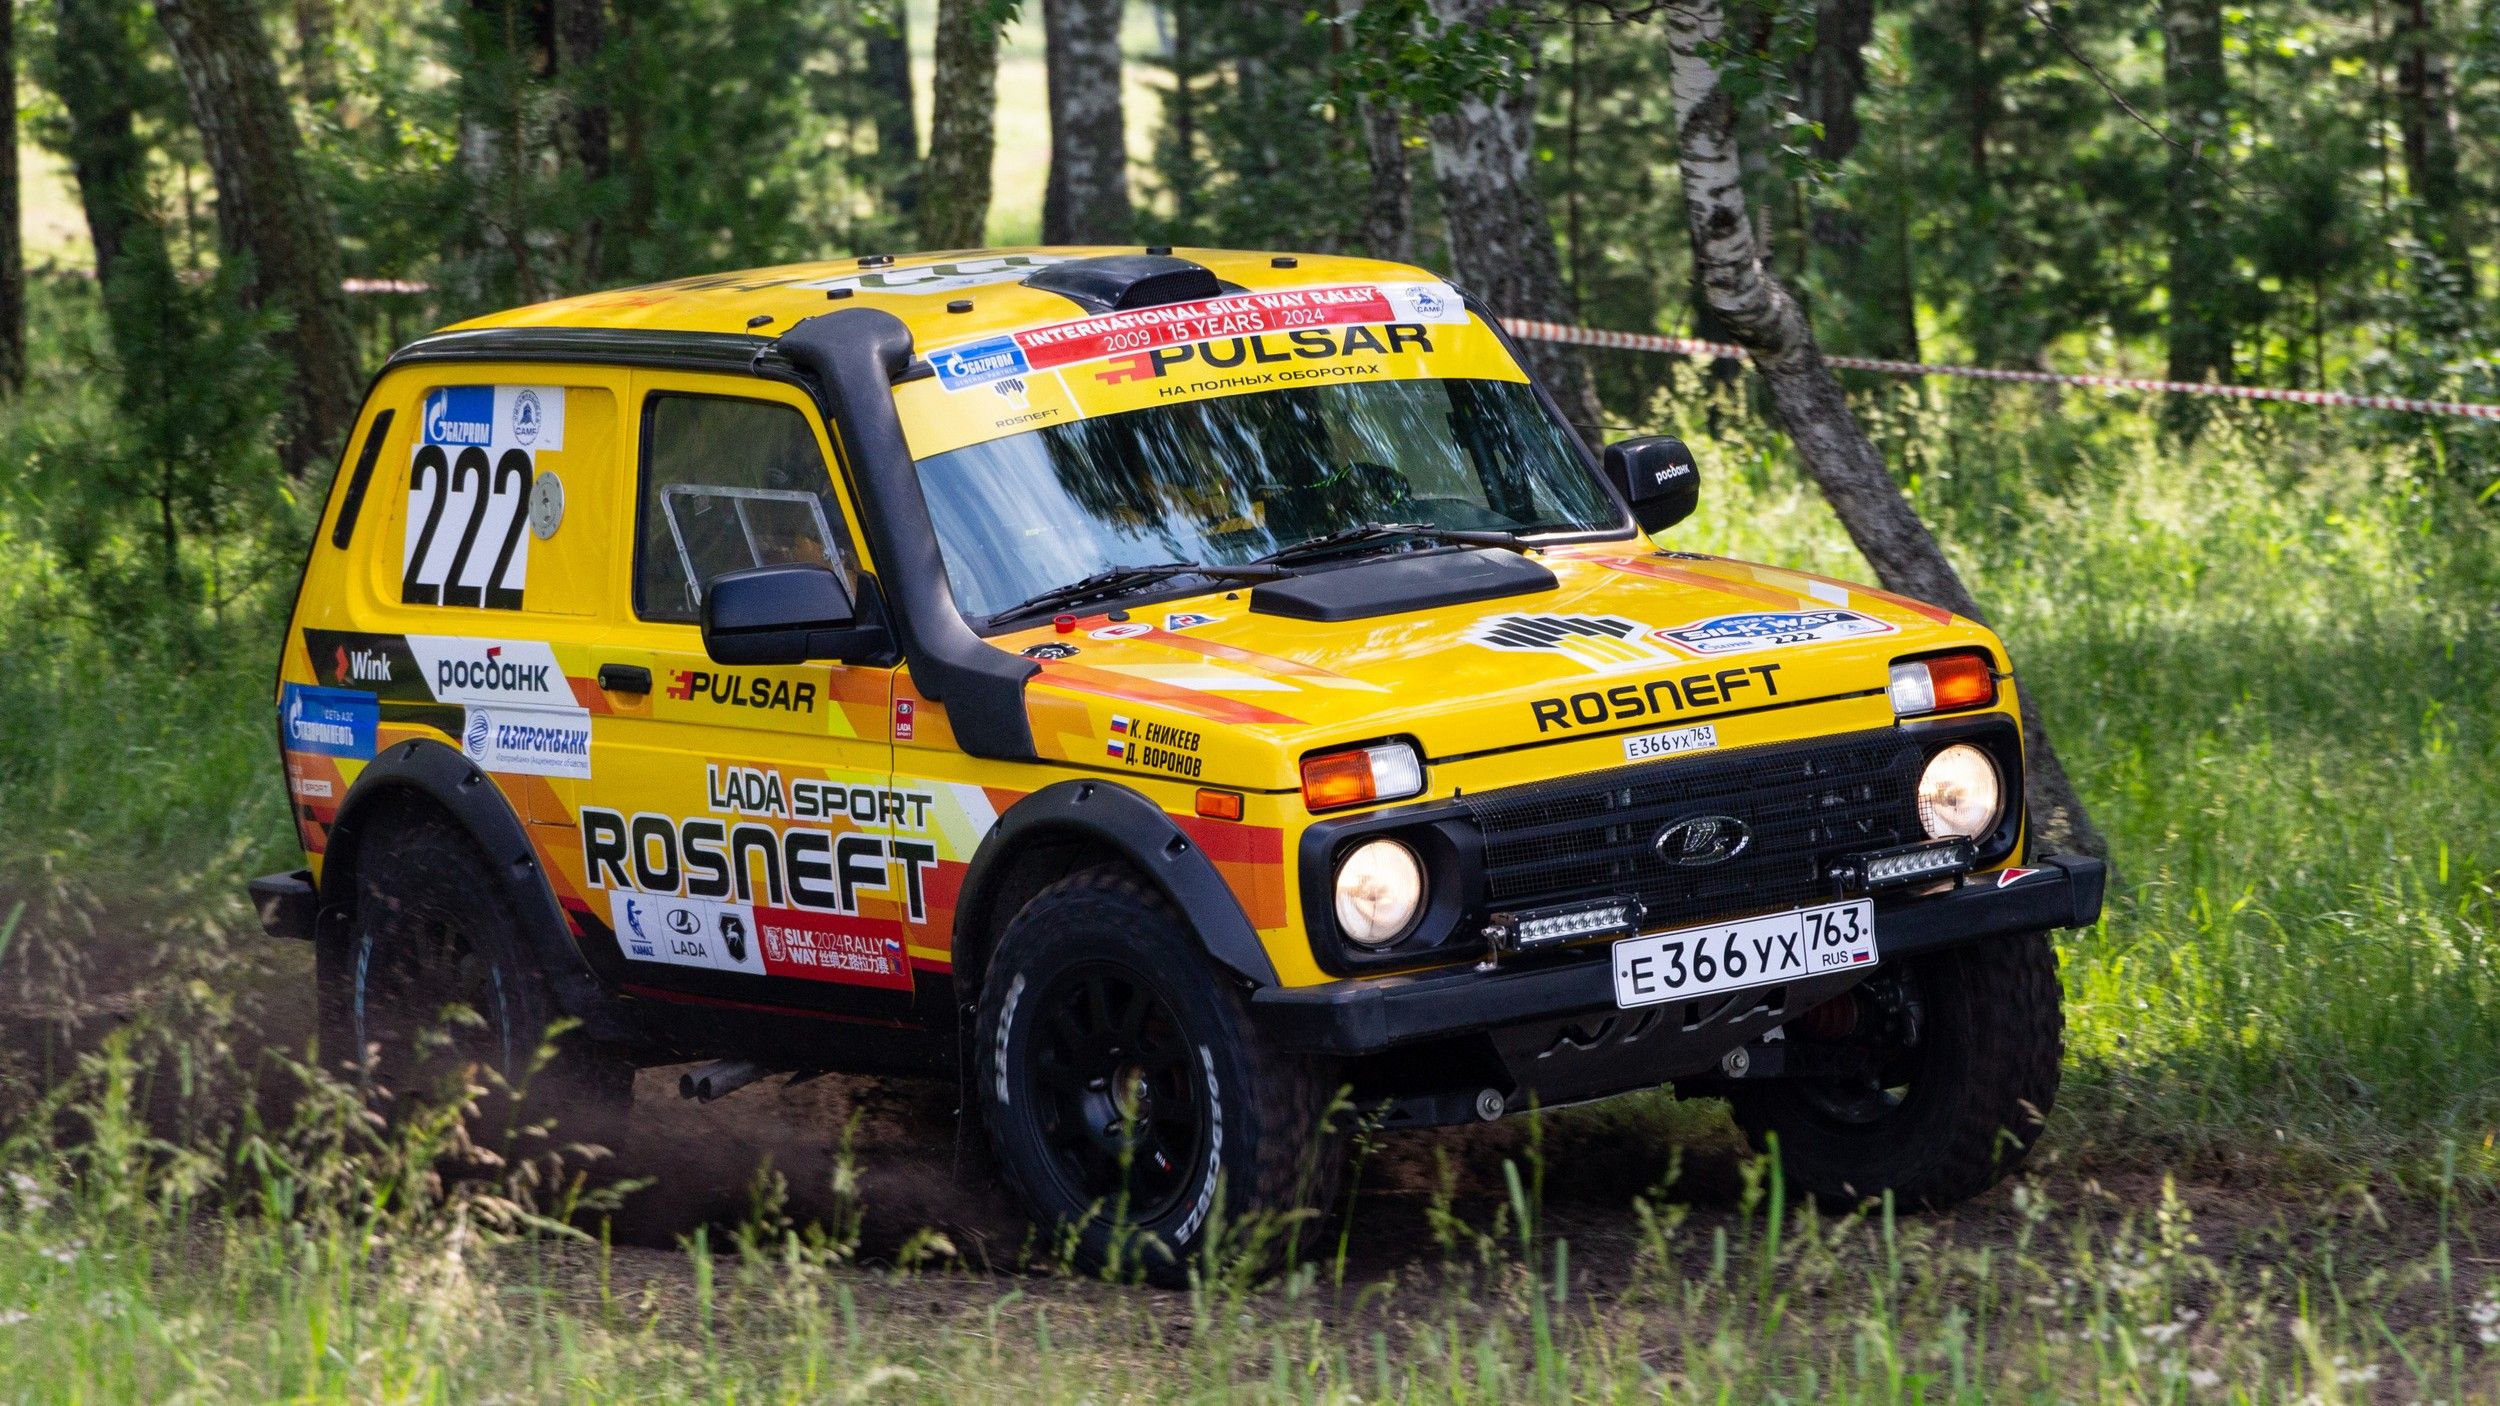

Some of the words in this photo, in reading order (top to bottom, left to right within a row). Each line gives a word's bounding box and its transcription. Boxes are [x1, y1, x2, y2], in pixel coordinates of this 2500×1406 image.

[1025, 304, 1207, 347] INTERNATIONAL
[1207, 297, 1256, 317] SILK
[1256, 290, 1308, 309] WAY
[1309, 287, 1376, 305] RALLY
[1104, 331, 1151, 352] 2009
[1167, 320, 1190, 342] 15
[1193, 313, 1265, 338] YEARS
[1283, 308, 1326, 326] 2024
[967, 352, 1015, 375] GAZPROM
[1150, 323, 1434, 377] PULSAR
[1159, 386, 1186, 397] НА
[1191, 374, 1274, 393] ПОЛНЫХ
[1278, 364, 1380, 381] ОБОРОТАХ
[448, 421, 490, 444] GAZPROM
[995, 408, 1059, 428] ROSNEFT
[402, 444, 534, 611] 222
[1682, 622, 1768, 641] SILK
[1765, 613, 1838, 629] WAY
[1766, 632, 1821, 644] 222
[351, 649, 392, 681] Wink
[438, 646, 549, 695] росбанк
[688, 671, 816, 714] PULSAR
[1531, 663, 1781, 732] ROSNEFT
[496, 725, 588, 755] ГАЗПРОМБАНК
[897, 723, 911, 731] LADA
[1130, 719, 1141, 739] К.
[1145, 722, 1200, 751] ЕНИКЕЕВ
[1690, 727, 1712, 741] 763
[1126, 742, 1138, 765] Д.
[1143, 746, 1202, 777] ВОРОНОВ
[709, 766, 789, 816] LADA
[792, 781, 933, 828] SPORT
[580, 808, 936, 921] ROSNEFT
[784, 928, 816, 949] SILK
[815, 931, 845, 951] 2024
[843, 934, 884, 955] RALLY
[1806, 907, 1860, 952] 763
[671, 939, 708, 958] LADA
[787, 946, 818, 967] WAY
[1822, 950, 1849, 966] RUS
